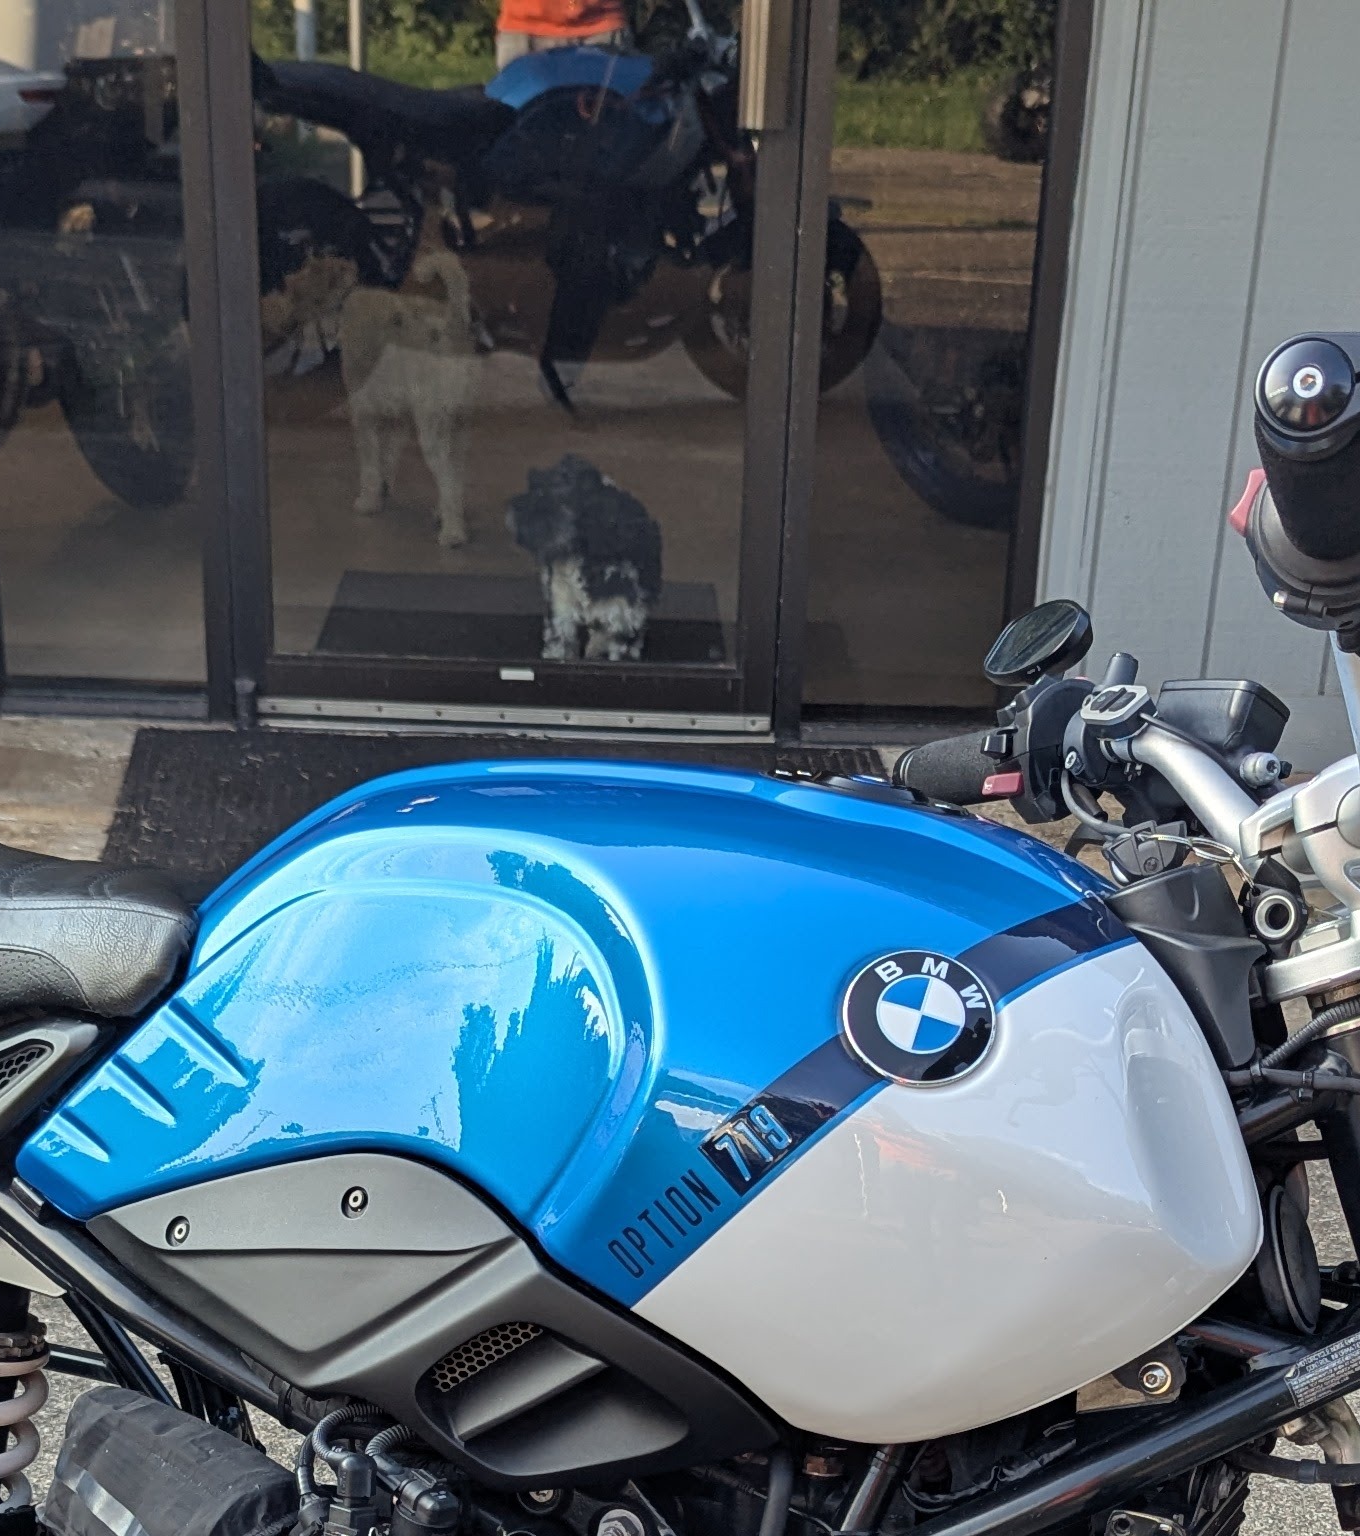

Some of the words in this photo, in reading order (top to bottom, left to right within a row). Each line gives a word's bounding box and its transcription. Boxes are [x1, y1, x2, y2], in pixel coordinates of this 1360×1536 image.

[874, 956, 987, 1010] BMW
[607, 1168, 722, 1279] OPTION
[714, 1103, 793, 1182] 719
